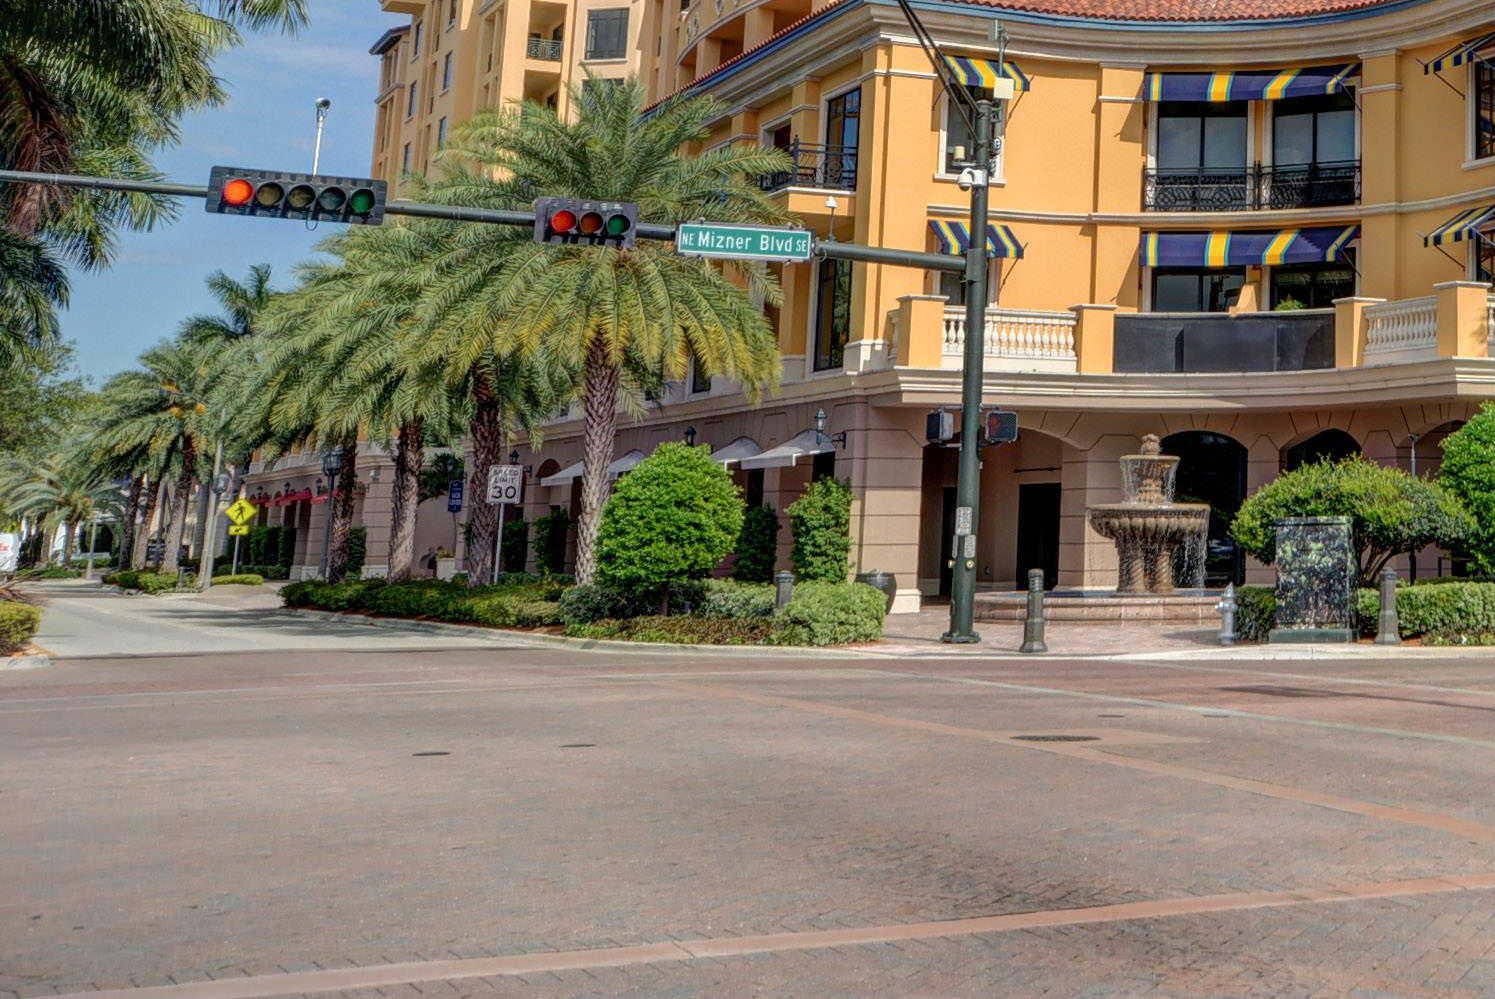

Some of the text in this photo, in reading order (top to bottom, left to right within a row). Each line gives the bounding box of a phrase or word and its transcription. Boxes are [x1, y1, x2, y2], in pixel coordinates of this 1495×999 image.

[681, 231, 807, 252] NE Mizner Blvd SE
[491, 486, 517, 499] 30
